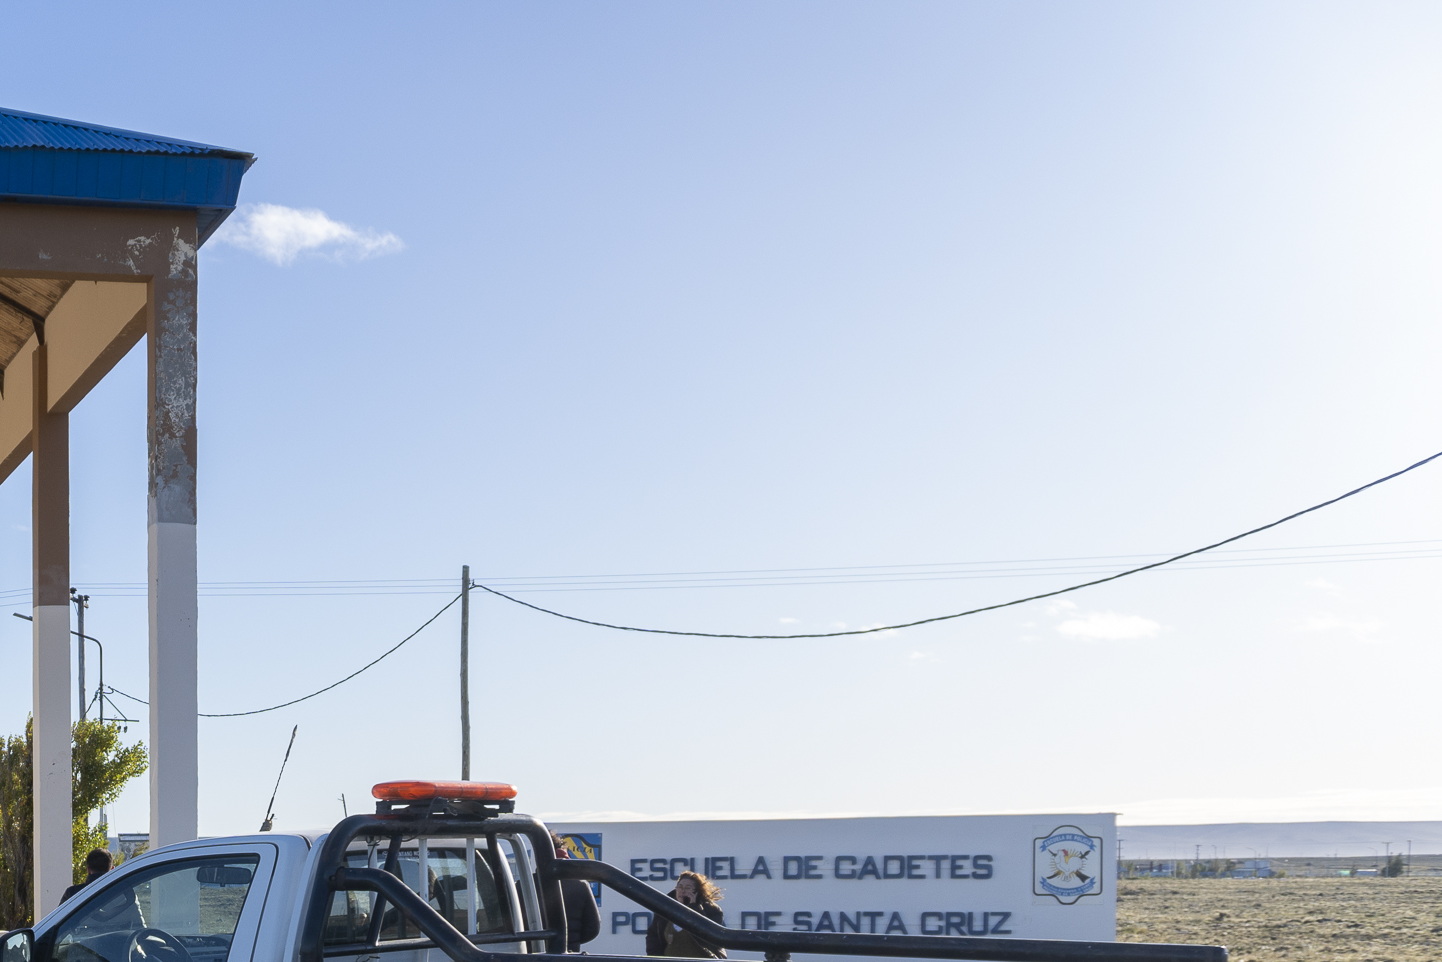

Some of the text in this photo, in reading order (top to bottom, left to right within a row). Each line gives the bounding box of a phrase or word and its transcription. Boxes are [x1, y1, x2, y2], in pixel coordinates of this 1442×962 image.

[783, 855, 824, 880] DE
[834, 855, 994, 880] CADETES
[792, 911, 908, 934] SANTA
[921, 911, 1012, 935] CRUZ
